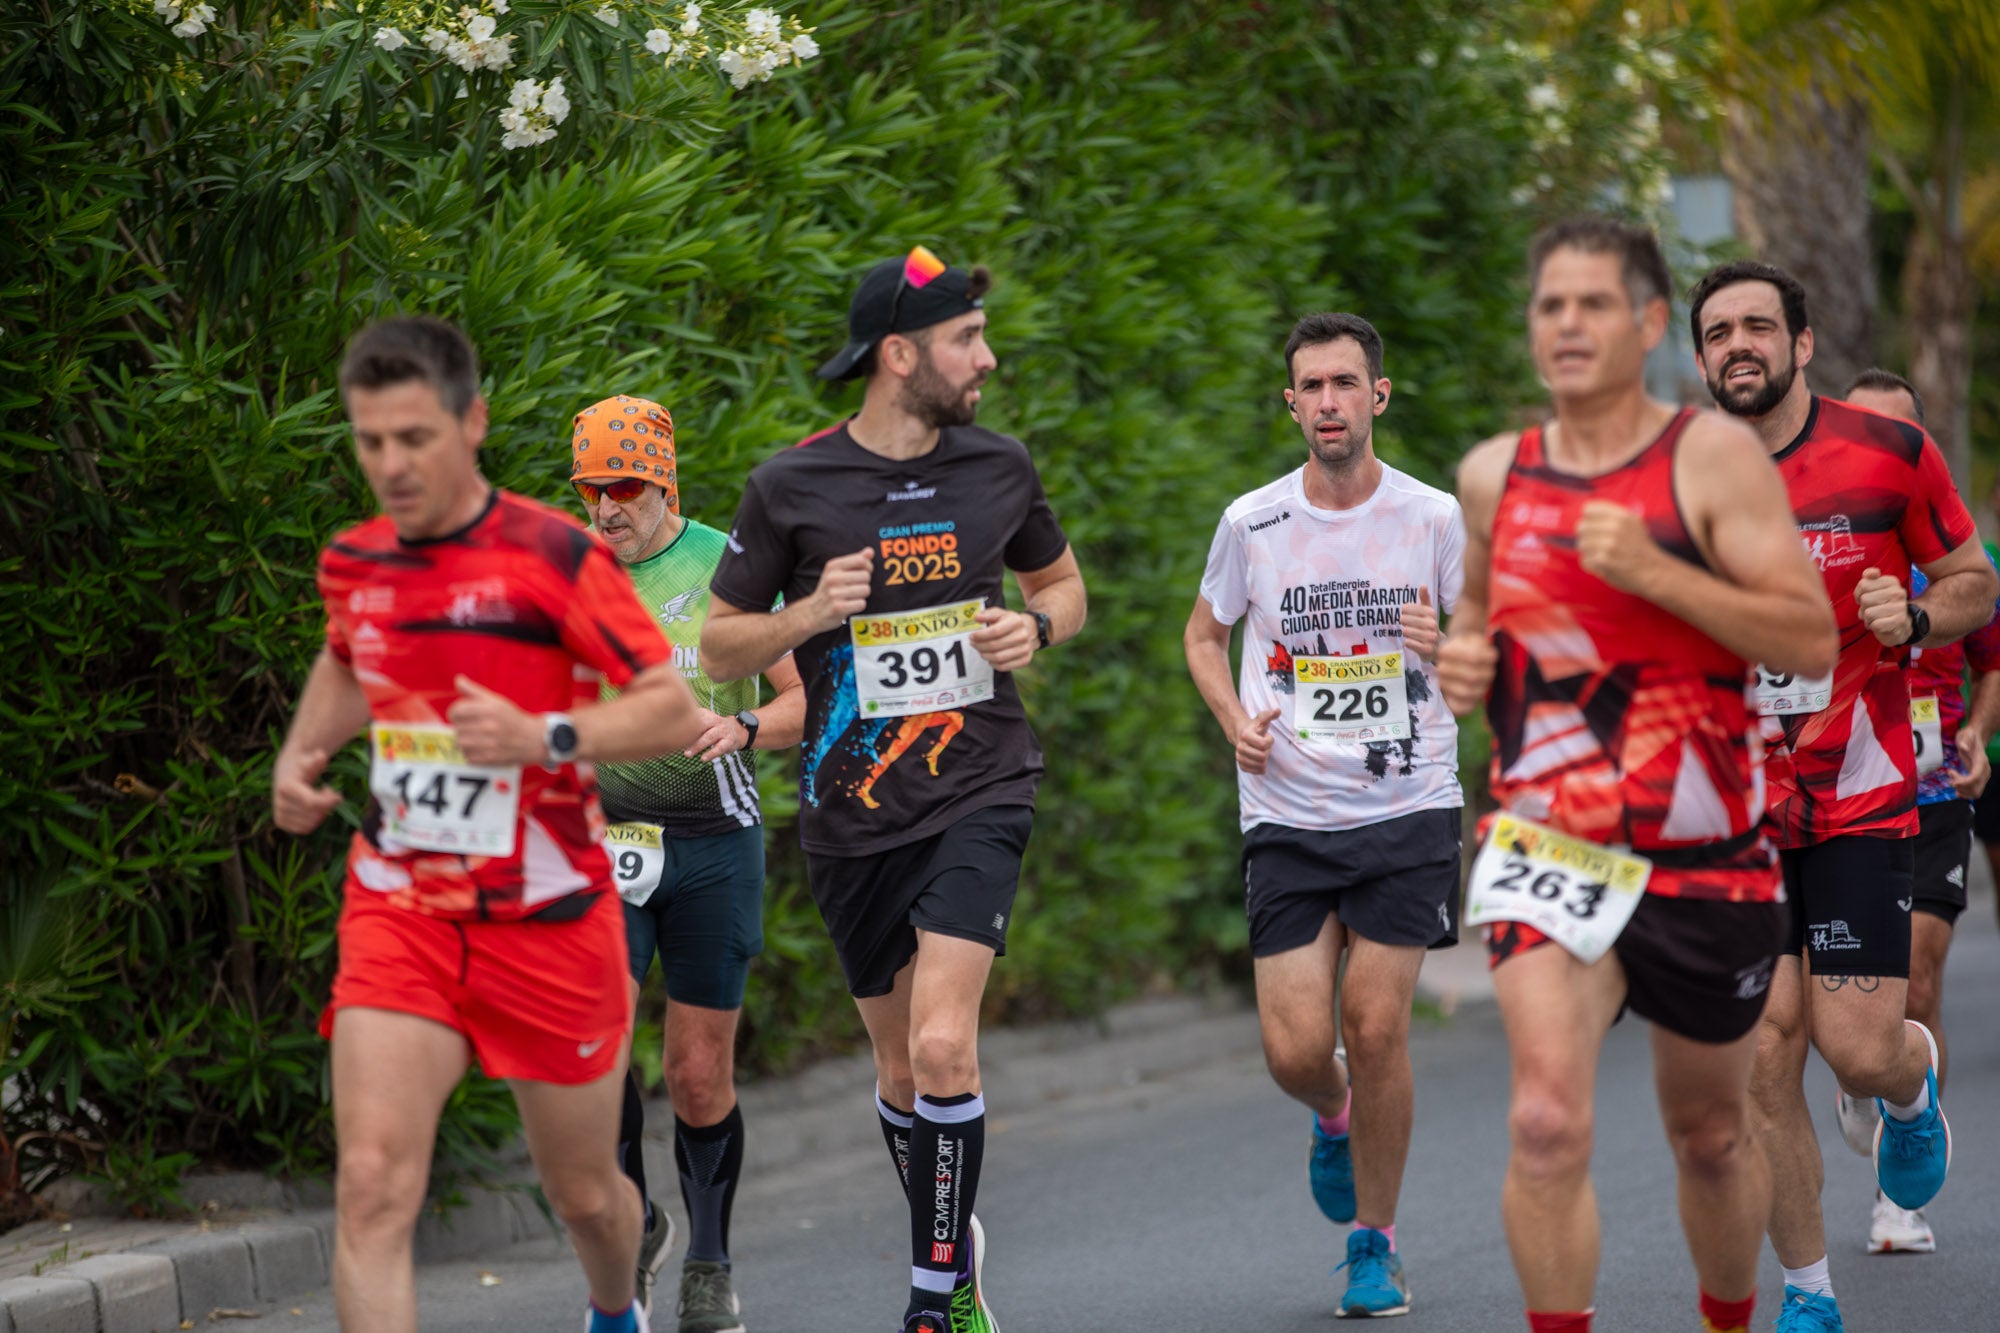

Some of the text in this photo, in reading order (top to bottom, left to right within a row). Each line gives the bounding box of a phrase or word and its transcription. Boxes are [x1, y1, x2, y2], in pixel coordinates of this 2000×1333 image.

[879, 521, 955, 538] GRAN PREMIO
[1249, 515, 1281, 533] luanvi
[880, 533, 957, 559] FONDO
[883, 551, 961, 586] 2025
[1280, 585, 1418, 615] 40 MEDIA MARATÓN
[1309, 579, 1370, 594] TotalEnergies
[872, 616, 959, 638] 38 FONDO
[1281, 606, 1402, 636] CIUDAD DE GRANA
[877, 640, 967, 689] 391
[1311, 662, 1327, 677] 38
[1327, 664, 1381, 678] FONDO
[1313, 685, 1389, 721] 226
[393, 771, 490, 820] 147
[1490, 862, 1608, 921] 263
